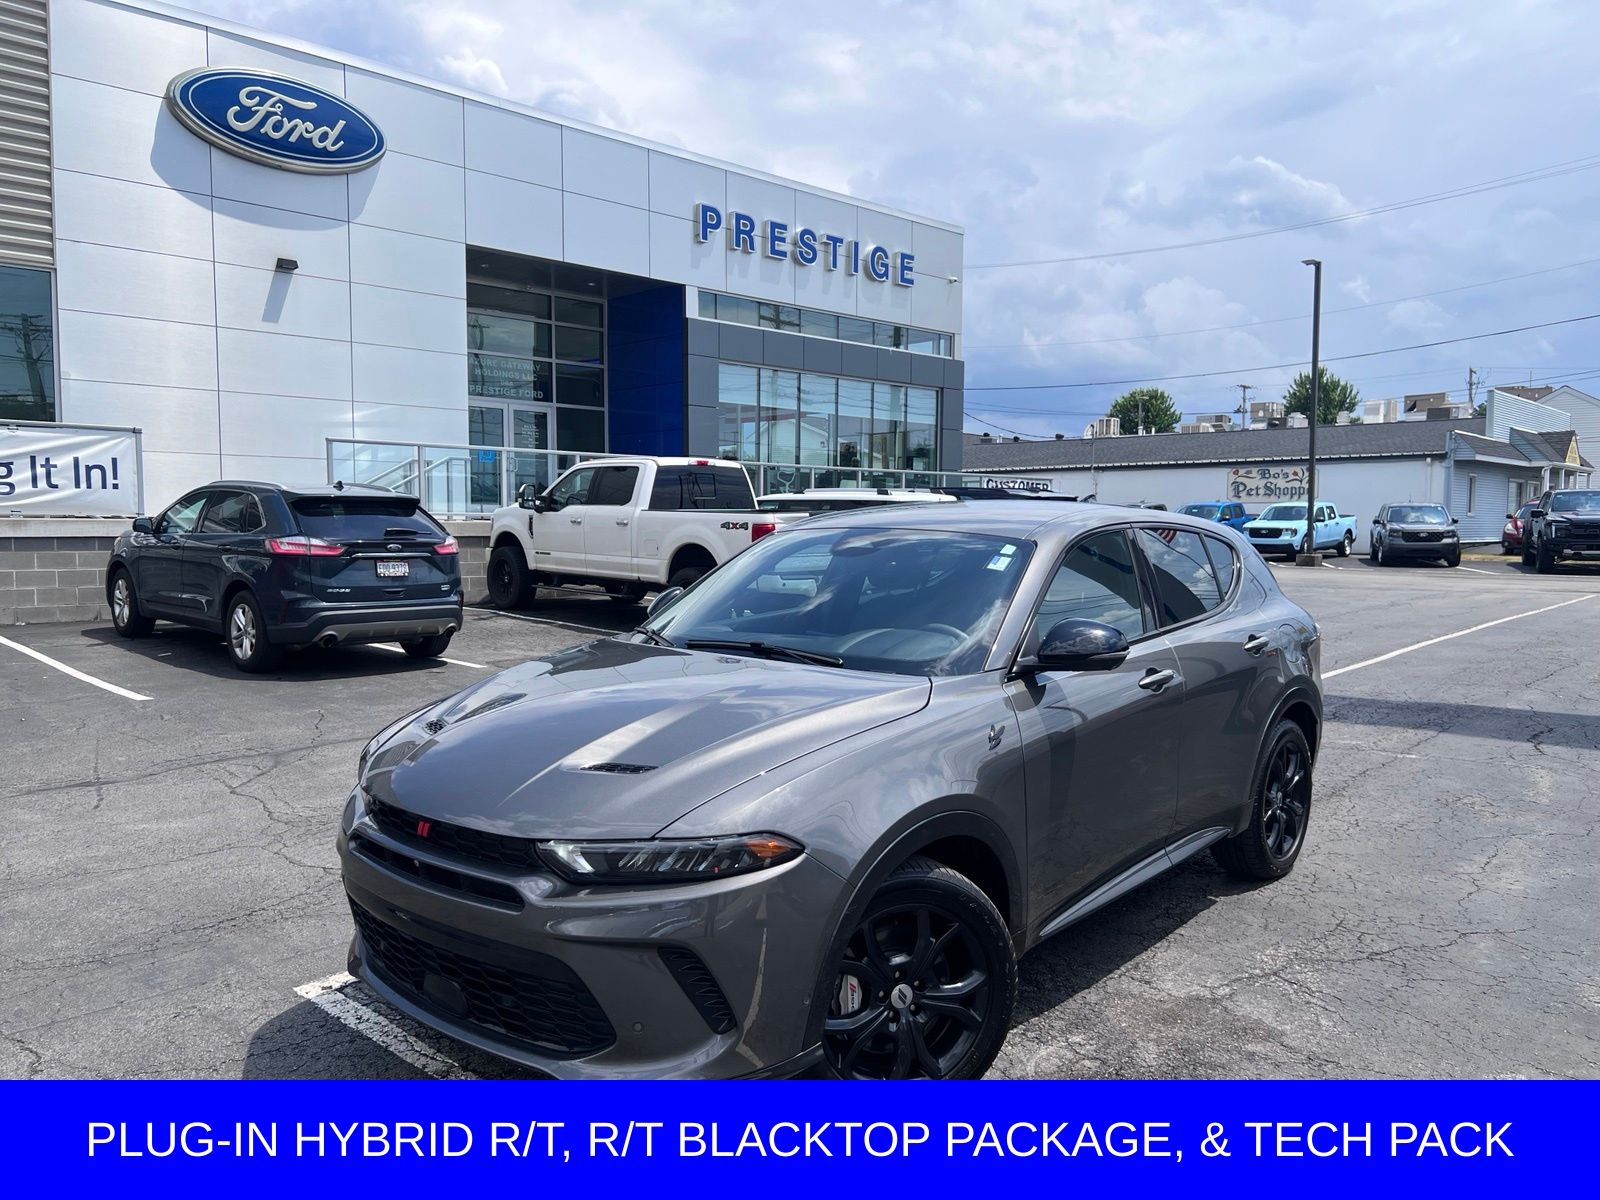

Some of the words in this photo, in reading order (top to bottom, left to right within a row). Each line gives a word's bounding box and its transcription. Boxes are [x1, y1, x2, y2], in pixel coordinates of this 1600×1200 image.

[227, 86, 346, 152] Ford
[695, 202, 915, 287] PRESTIGE
[471, 356, 498, 367] AZURE
[500, 360, 541, 372] GATEWAY
[474, 368, 520, 379] HOLDINGS
[522, 372, 538, 381] LLC
[469, 385, 517, 396] PRESTIGE
[519, 389, 544, 399] FORD
[30, 455, 59, 489] It
[73, 456, 119, 490] In!
[1257, 468, 1290, 480] Bo's
[1231, 481, 1261, 499] Pet
